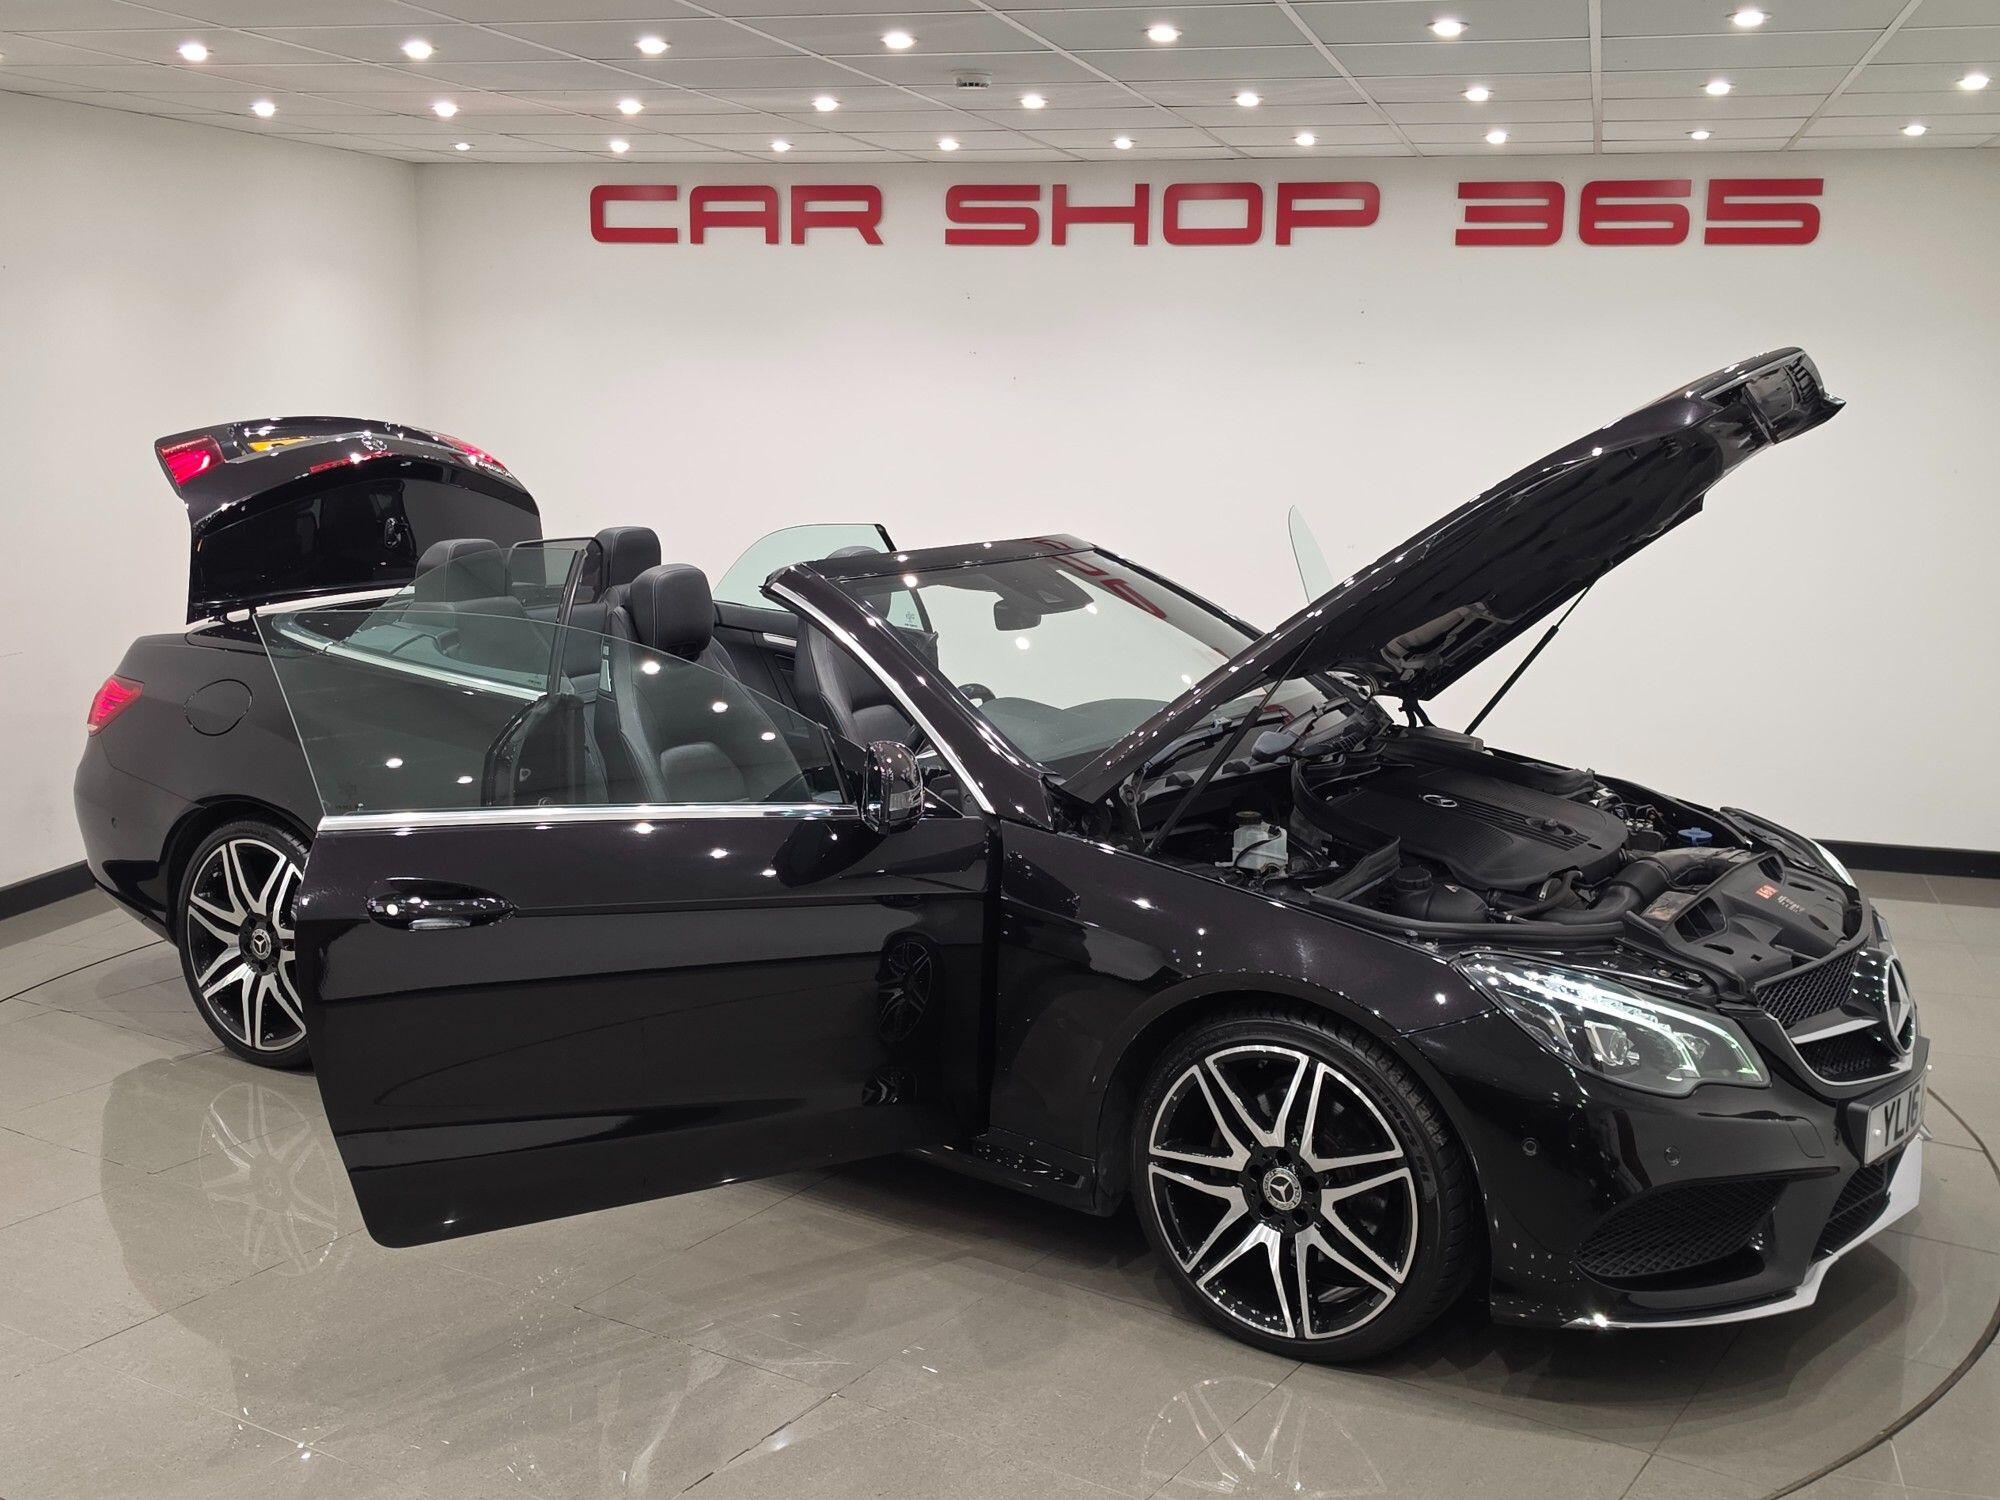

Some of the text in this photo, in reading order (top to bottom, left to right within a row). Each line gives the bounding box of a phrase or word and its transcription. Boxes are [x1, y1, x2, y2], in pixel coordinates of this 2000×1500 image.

[590, 178, 1823, 247] CAR SHOP 365
